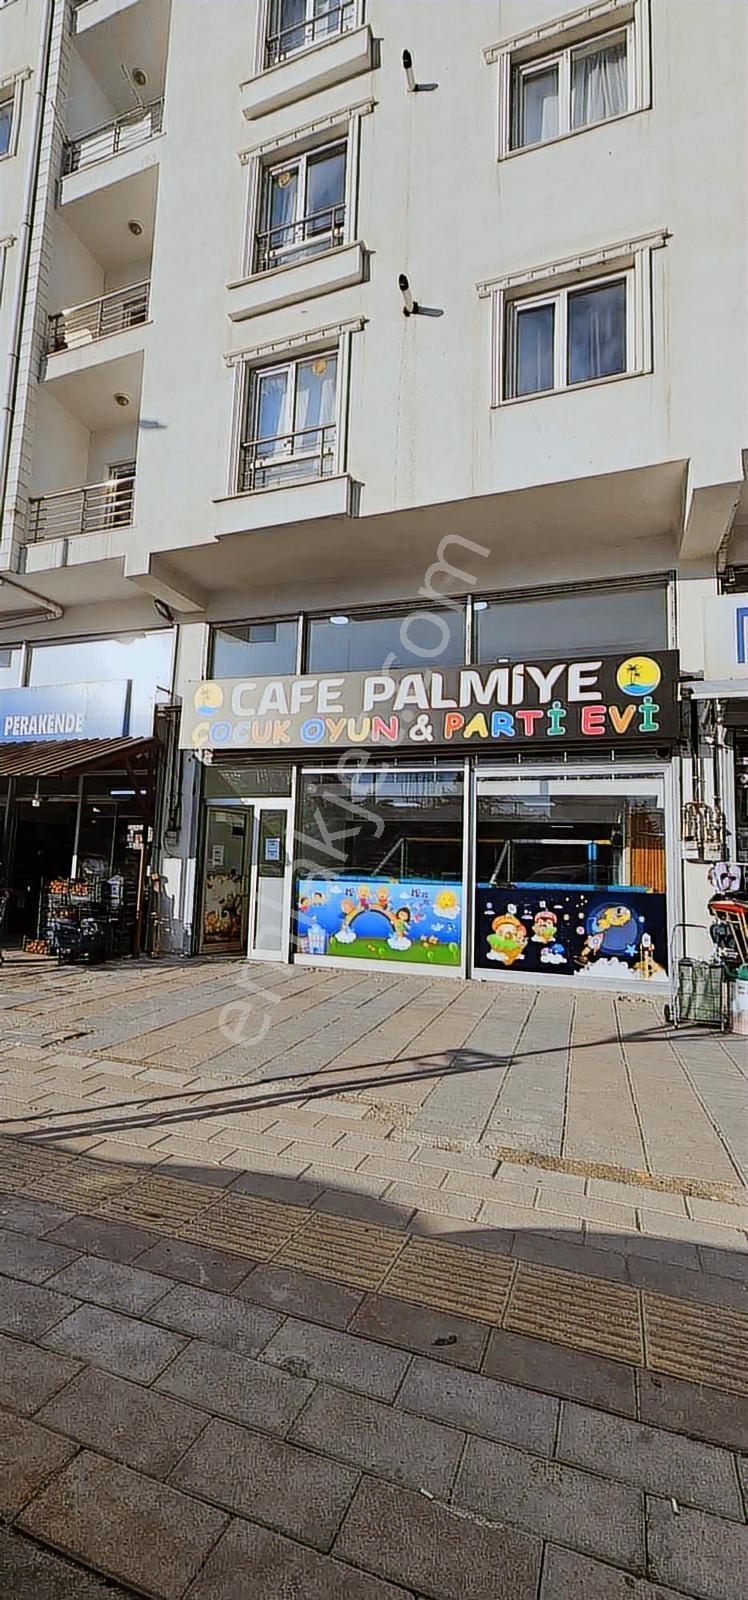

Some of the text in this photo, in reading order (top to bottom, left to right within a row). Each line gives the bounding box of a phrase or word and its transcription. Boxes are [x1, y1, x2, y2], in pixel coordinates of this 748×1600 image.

[231, 661, 603, 717] CAFE PALMİYE
[3, 713, 84, 736] PERAKENDE
[192, 695, 661, 748] ÇOCUK OYUN & PARTİ EVİ
